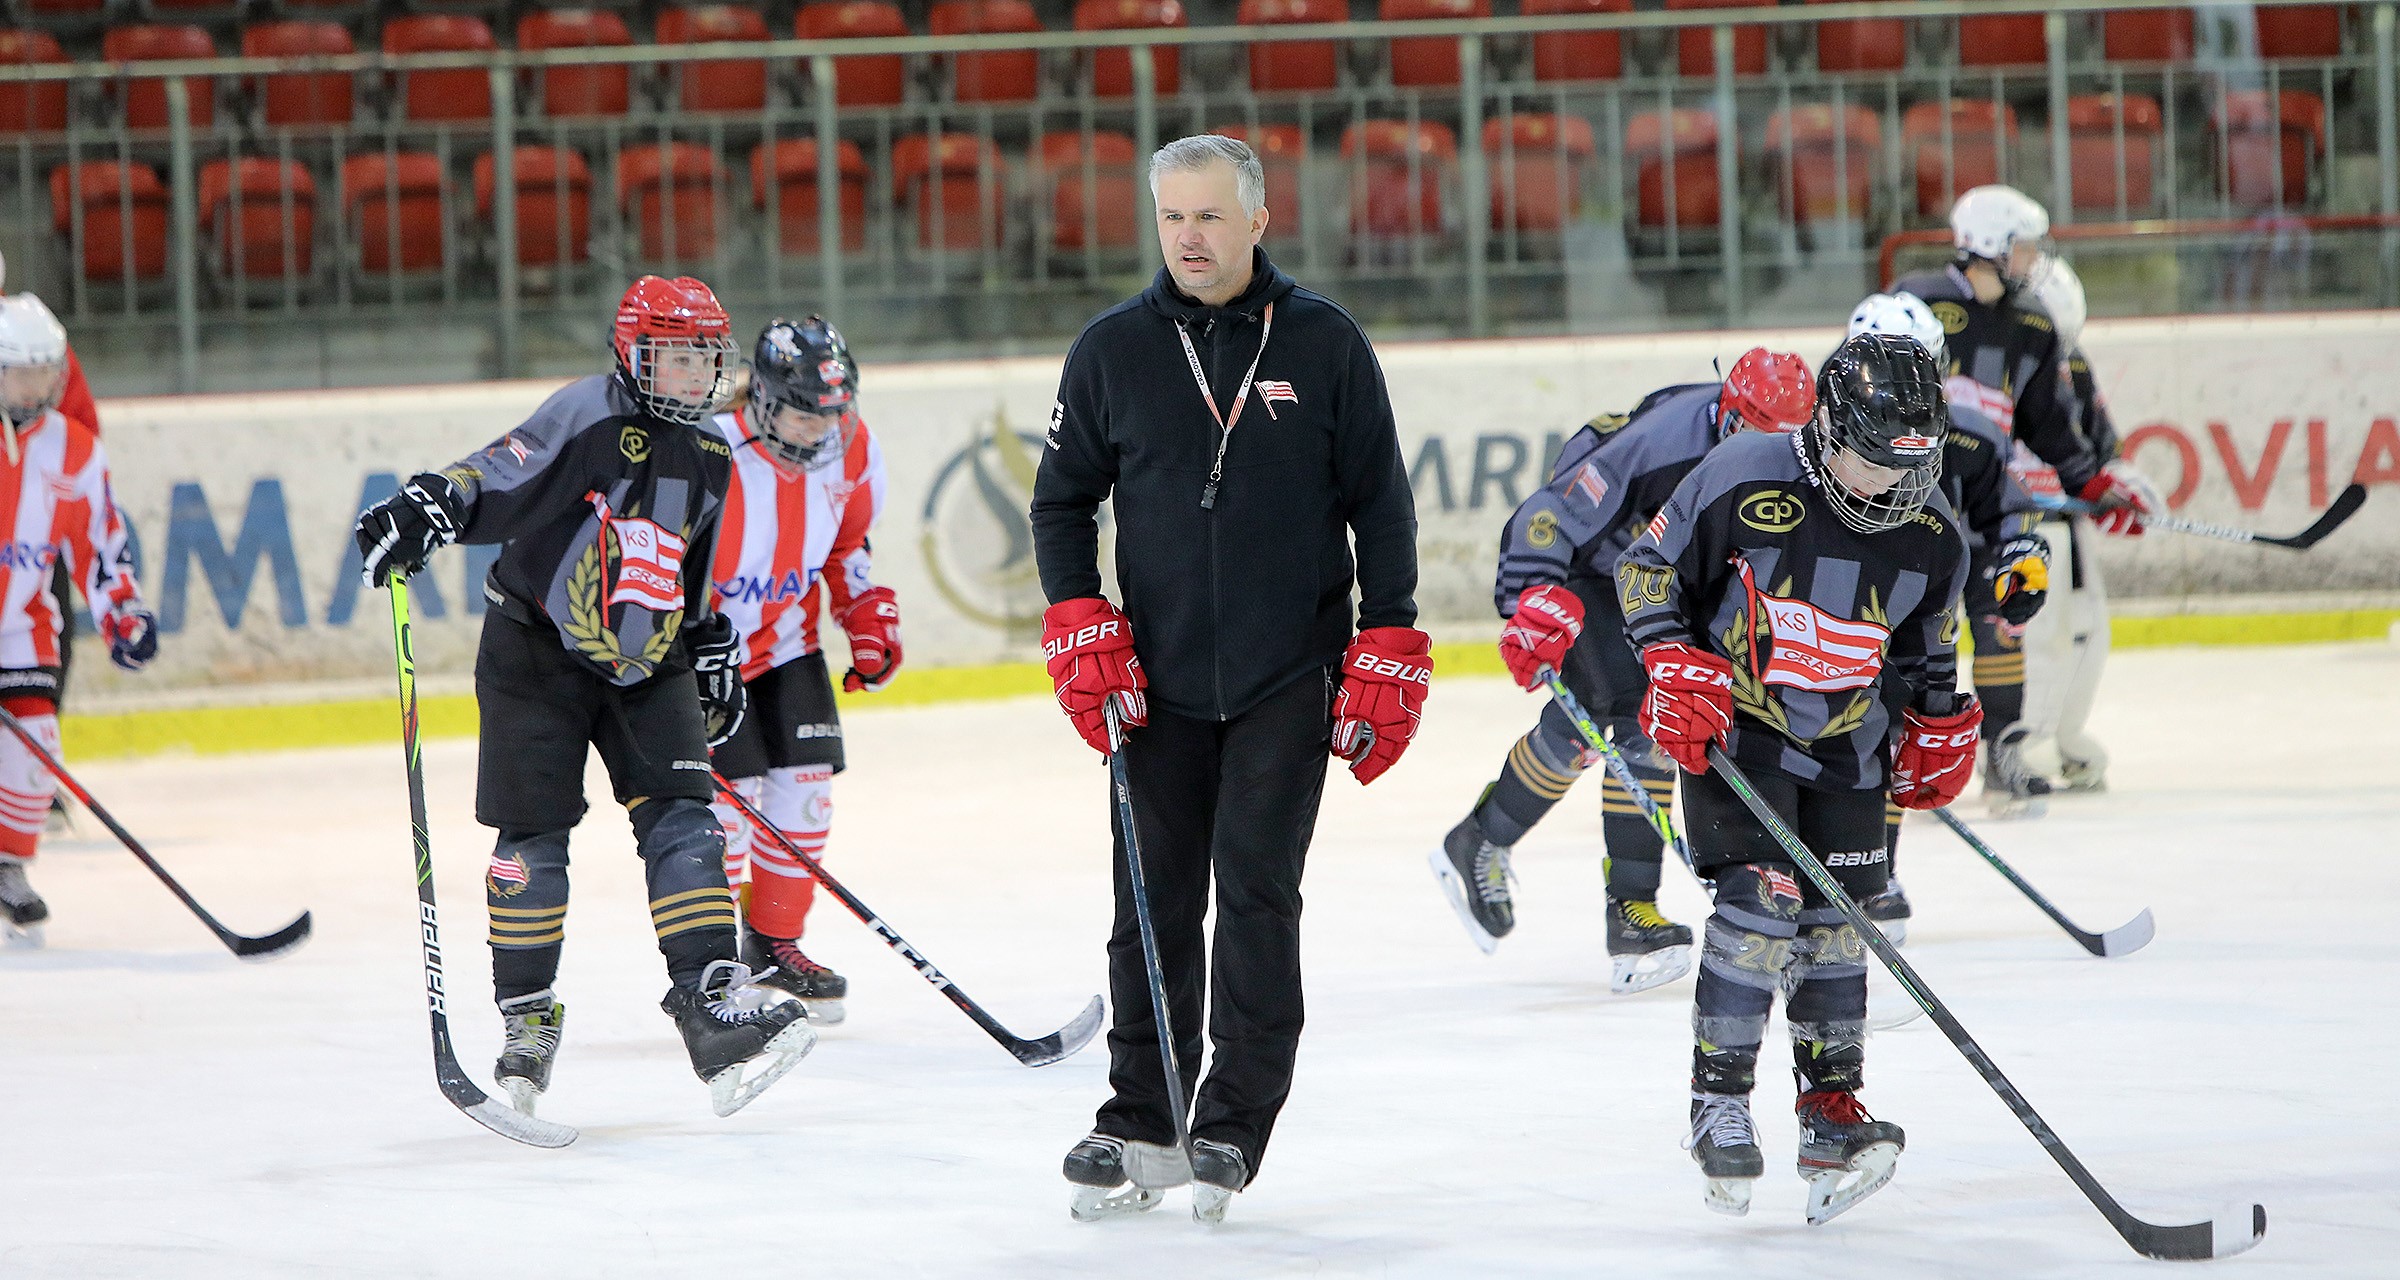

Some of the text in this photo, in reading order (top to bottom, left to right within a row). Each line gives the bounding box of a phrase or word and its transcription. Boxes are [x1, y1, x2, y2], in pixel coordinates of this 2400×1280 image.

[1186, 345, 1205, 386] CRACOVIA.PL
[1891, 448, 1930, 456] BAUER
[623, 530, 650, 548] KS
[1526, 508, 1559, 549] 8
[1618, 560, 1677, 617] 20
[1774, 610, 1807, 632] KS
[1653, 662, 1732, 691] CCM
[420, 900, 446, 1016] BAUER
[867, 917, 951, 991] CCM
[1733, 933, 1788, 974] 20
[1809, 924, 1862, 963] 20
